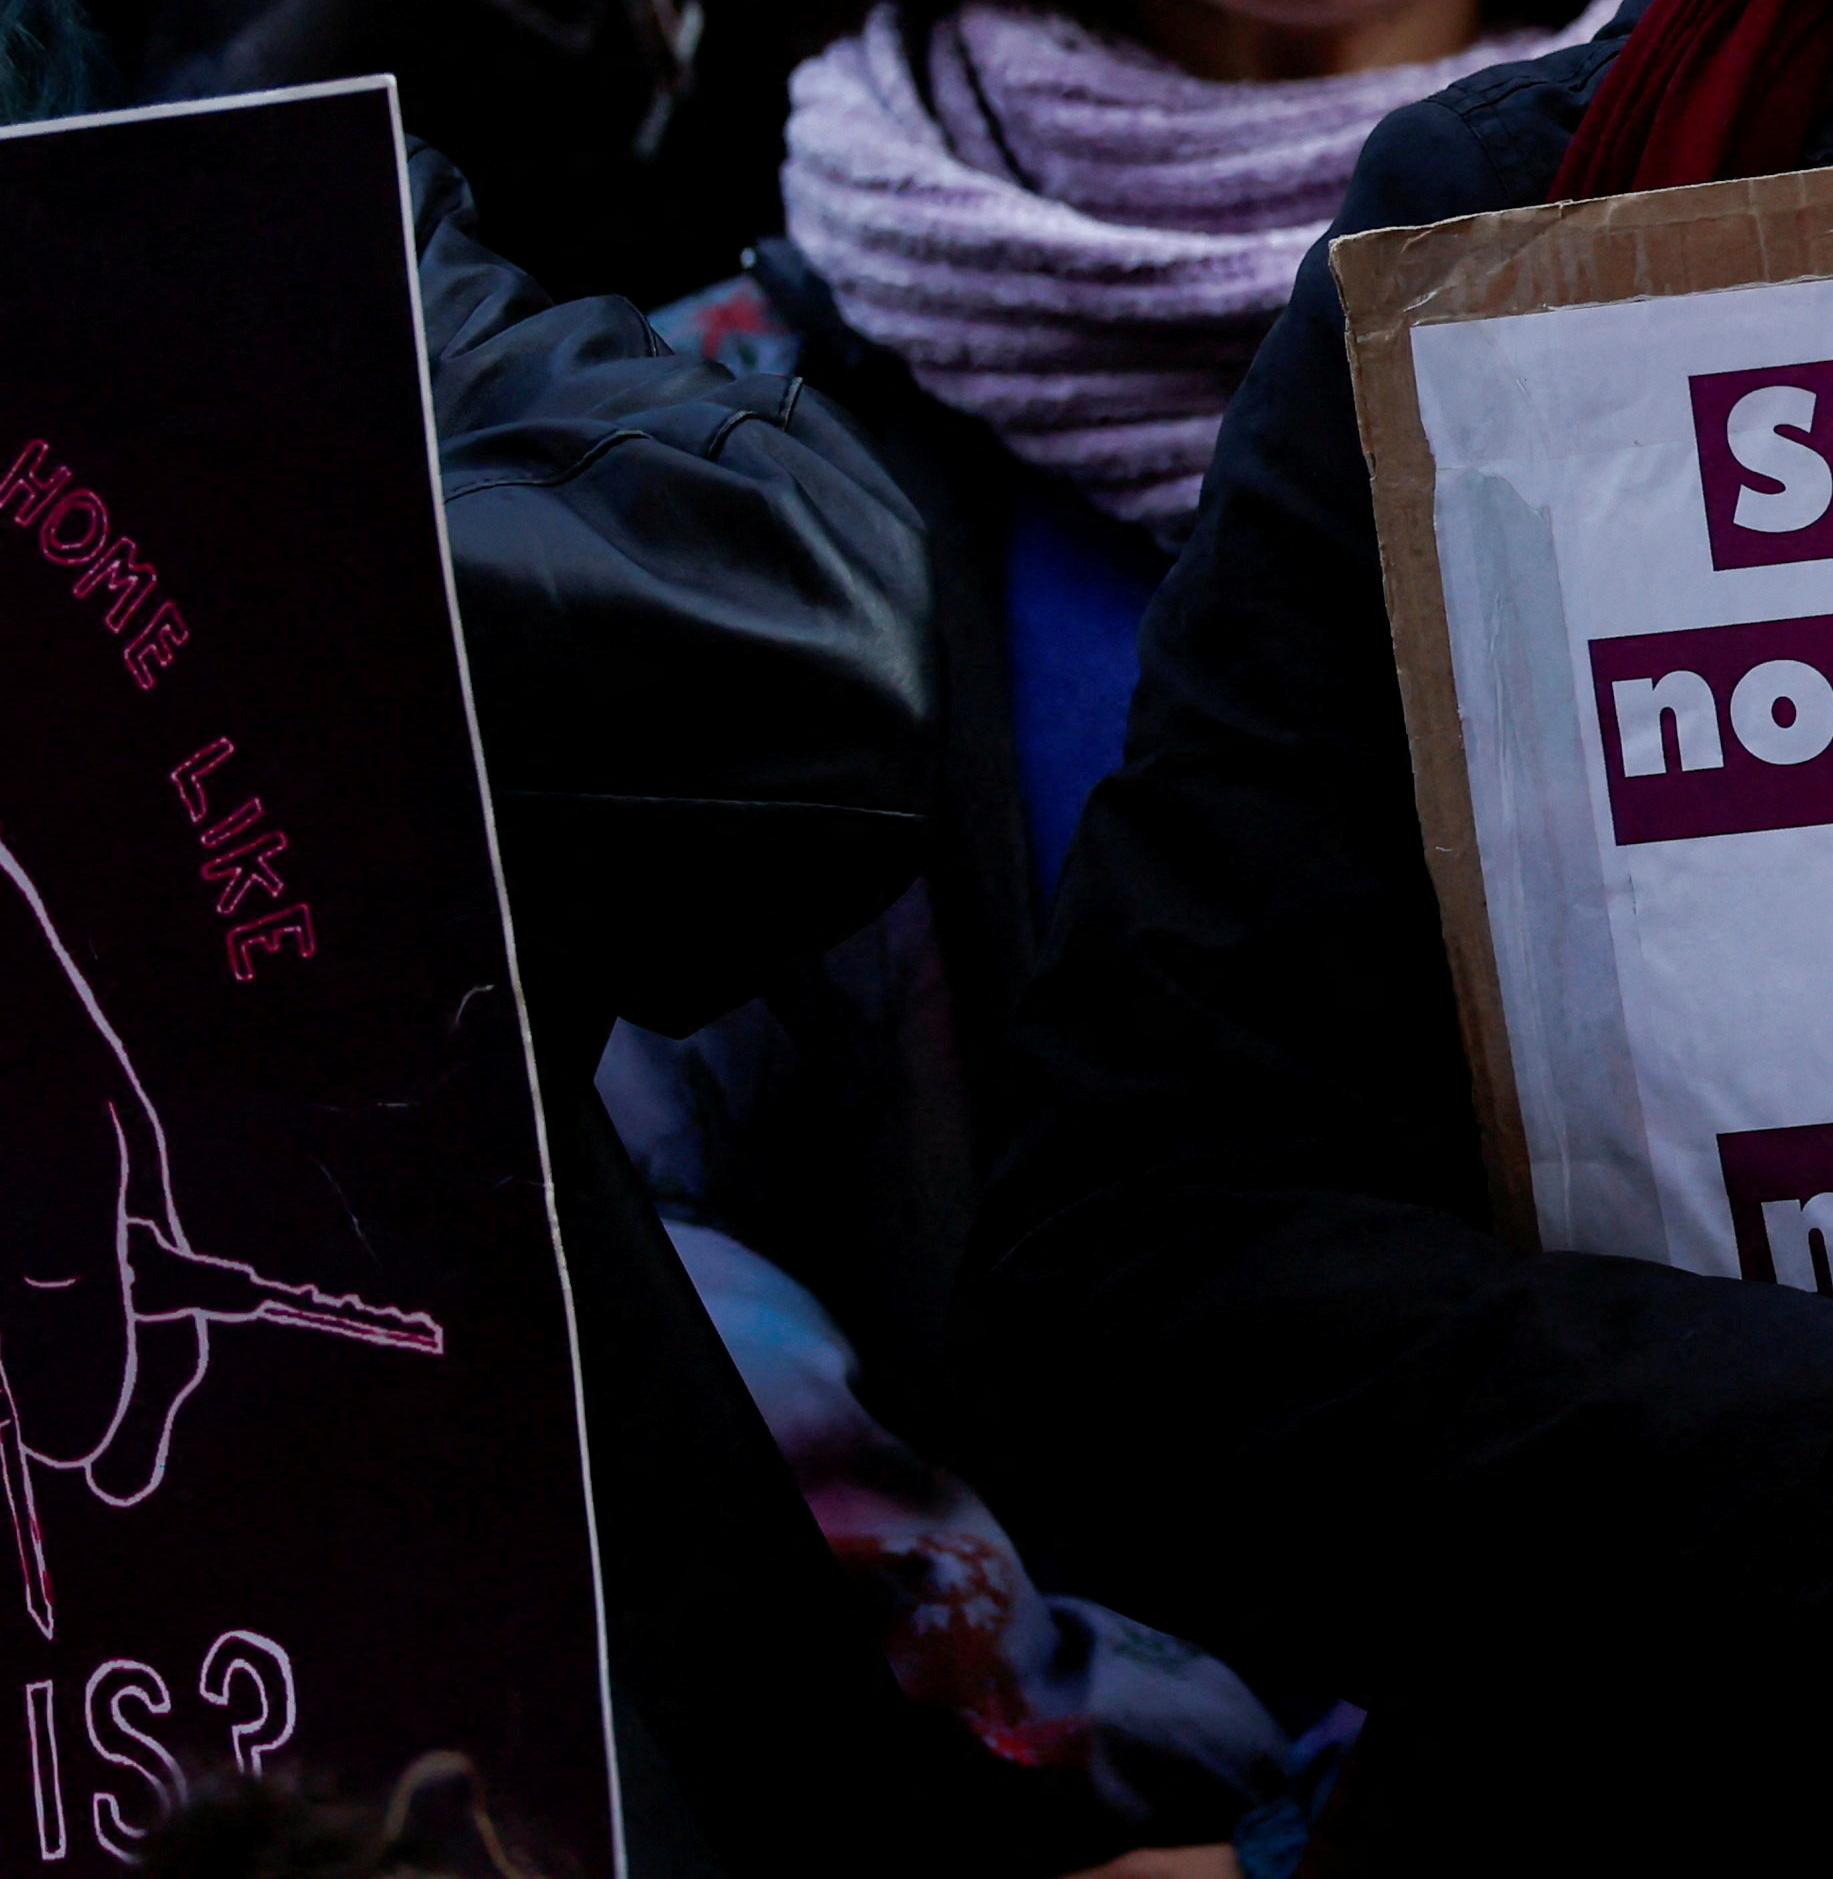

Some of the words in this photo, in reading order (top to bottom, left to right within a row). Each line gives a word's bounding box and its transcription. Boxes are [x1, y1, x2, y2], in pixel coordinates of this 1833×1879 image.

[0, 438, 189, 690] HOME
[171, 738, 316, 981] LIKE
[26, 1629, 297, 1864] IS?
